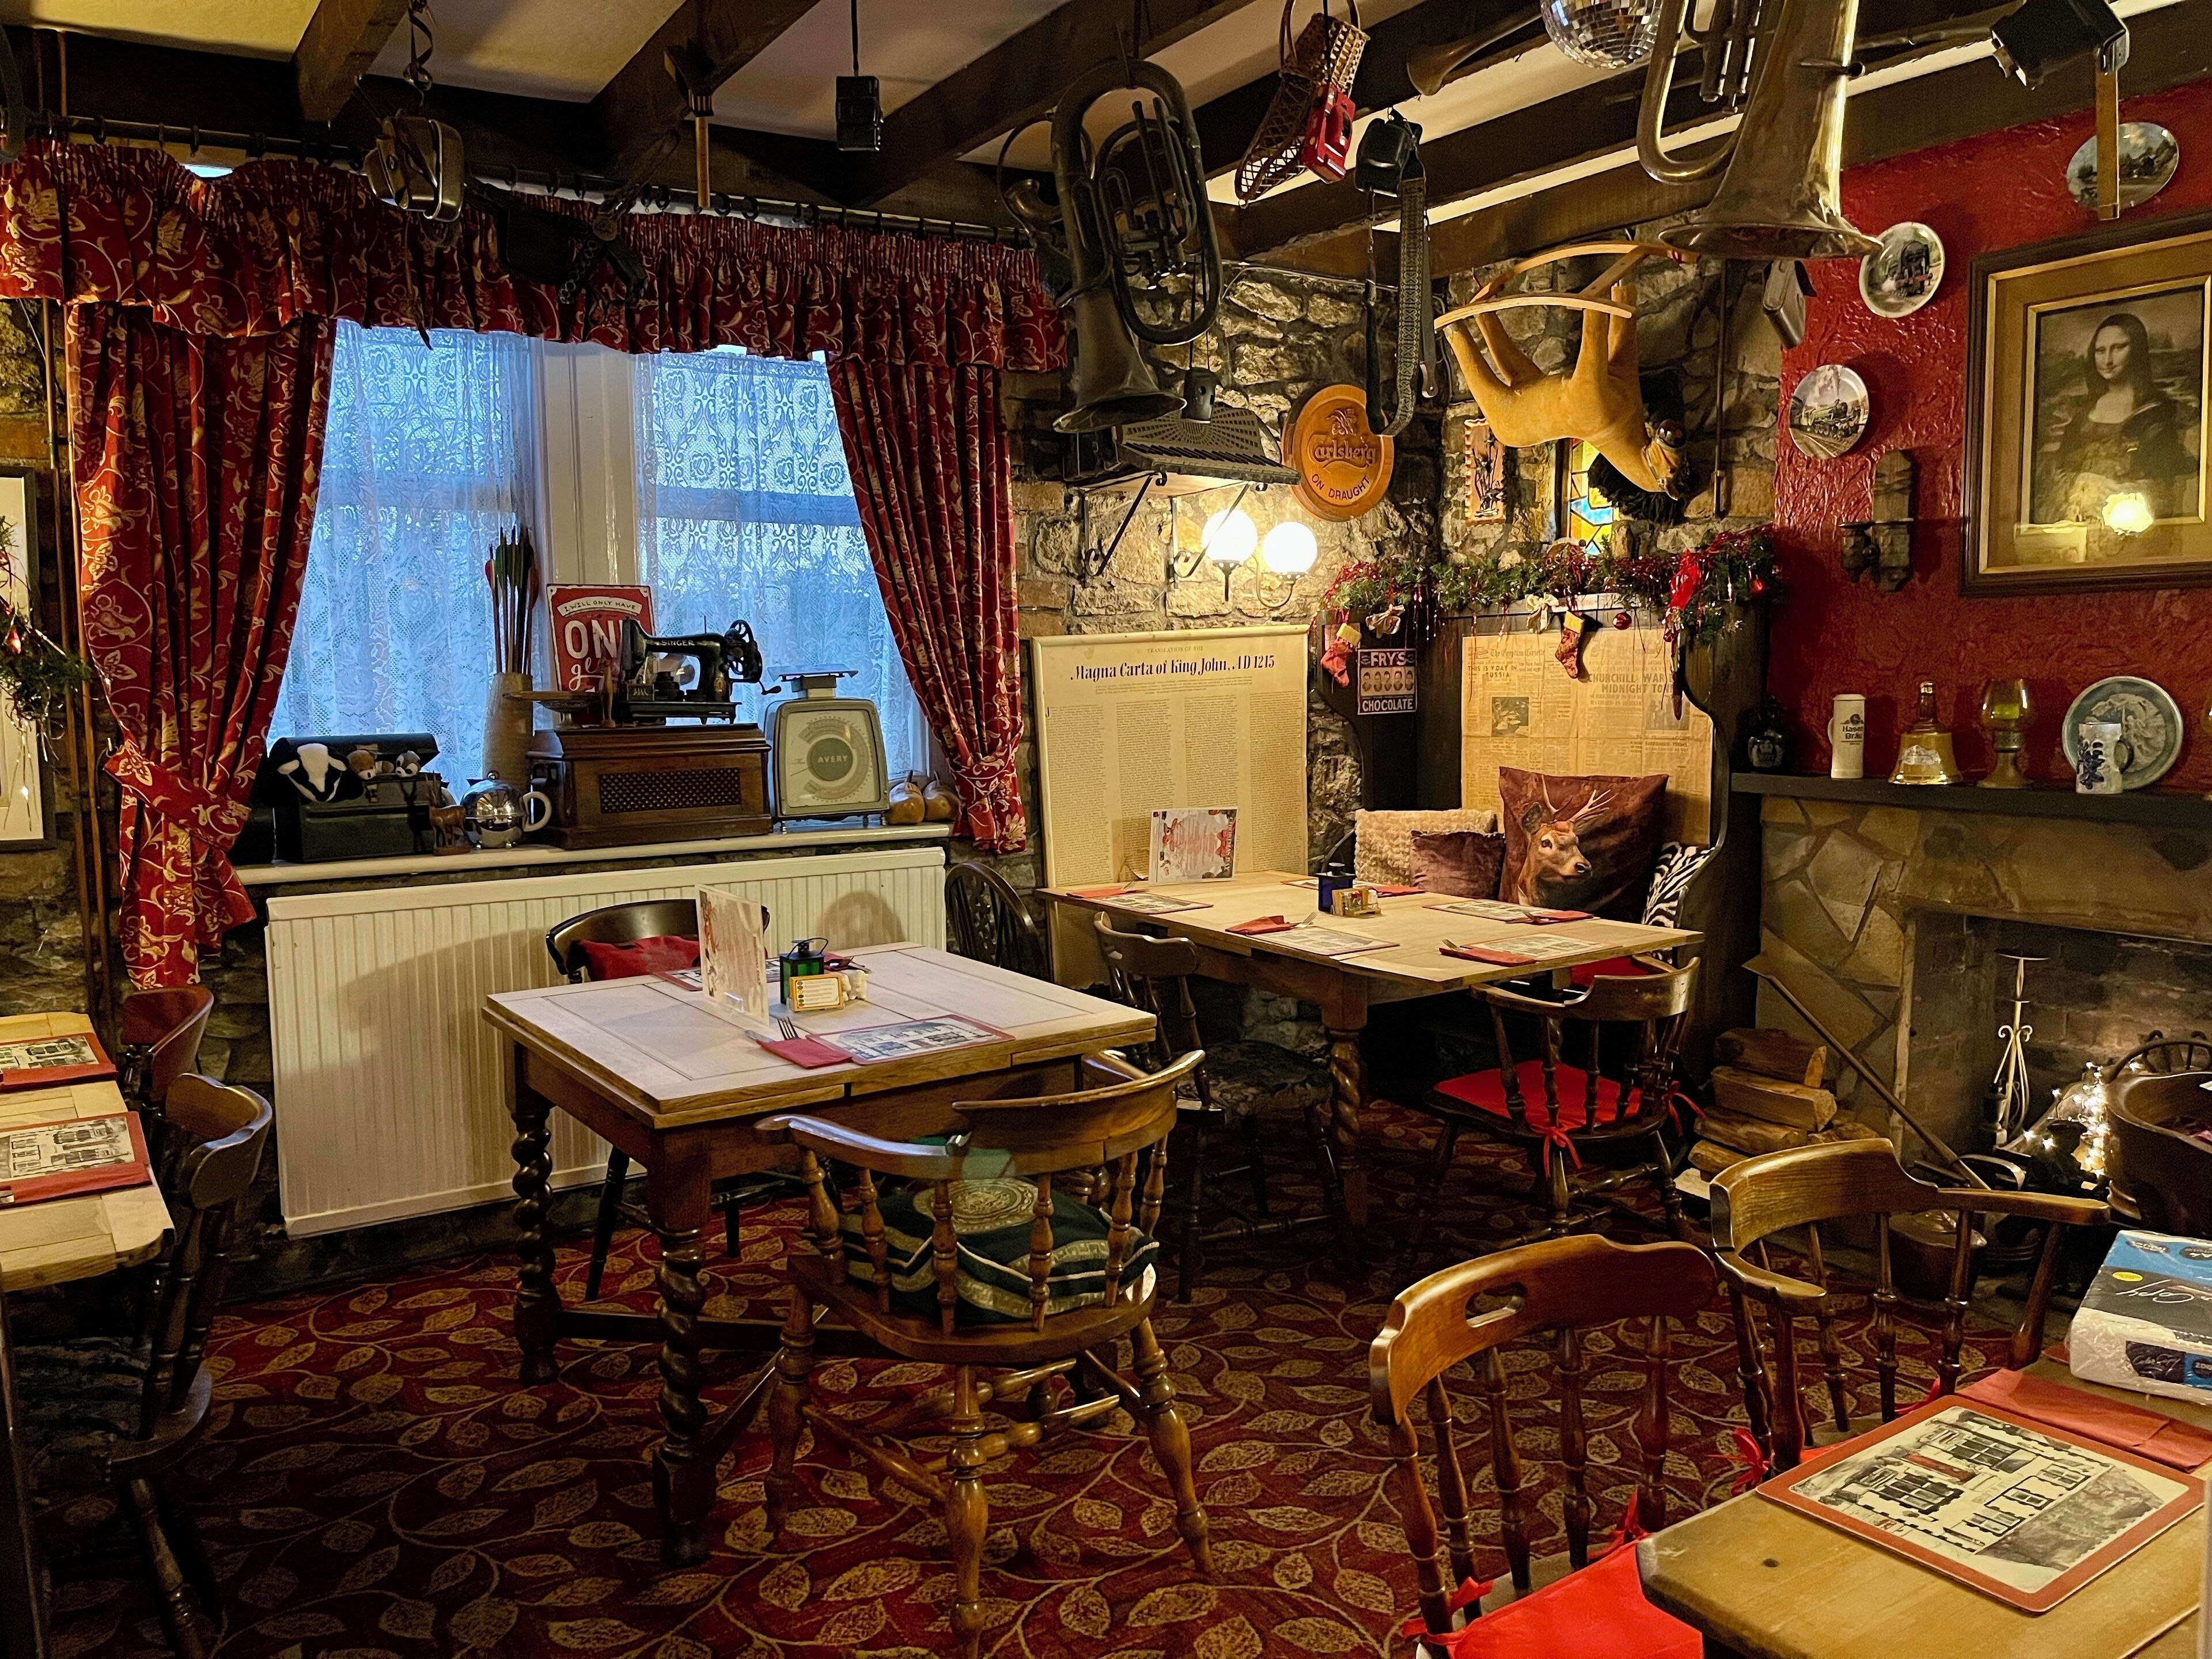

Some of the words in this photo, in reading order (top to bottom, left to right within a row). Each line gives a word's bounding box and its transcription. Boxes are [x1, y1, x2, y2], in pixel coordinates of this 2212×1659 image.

[1312, 474, 1324, 490] ON
[1328, 476, 1370, 500] DRAUGHT
[1371, 652, 1406, 666] FRY'S
[1070, 665, 1116, 682] Magna
[1120, 662, 1153, 677] Carta
[1156, 660, 1168, 674] of
[1171, 659, 1196, 676] King
[1254, 655, 1275, 668] 1215
[1602, 684, 1646, 693] MIDNIGHT
[1362, 699, 1414, 712] CHOCOLATE
[817, 755, 848, 763] AVERY
[2115, 1279, 2194, 1304] Copy
